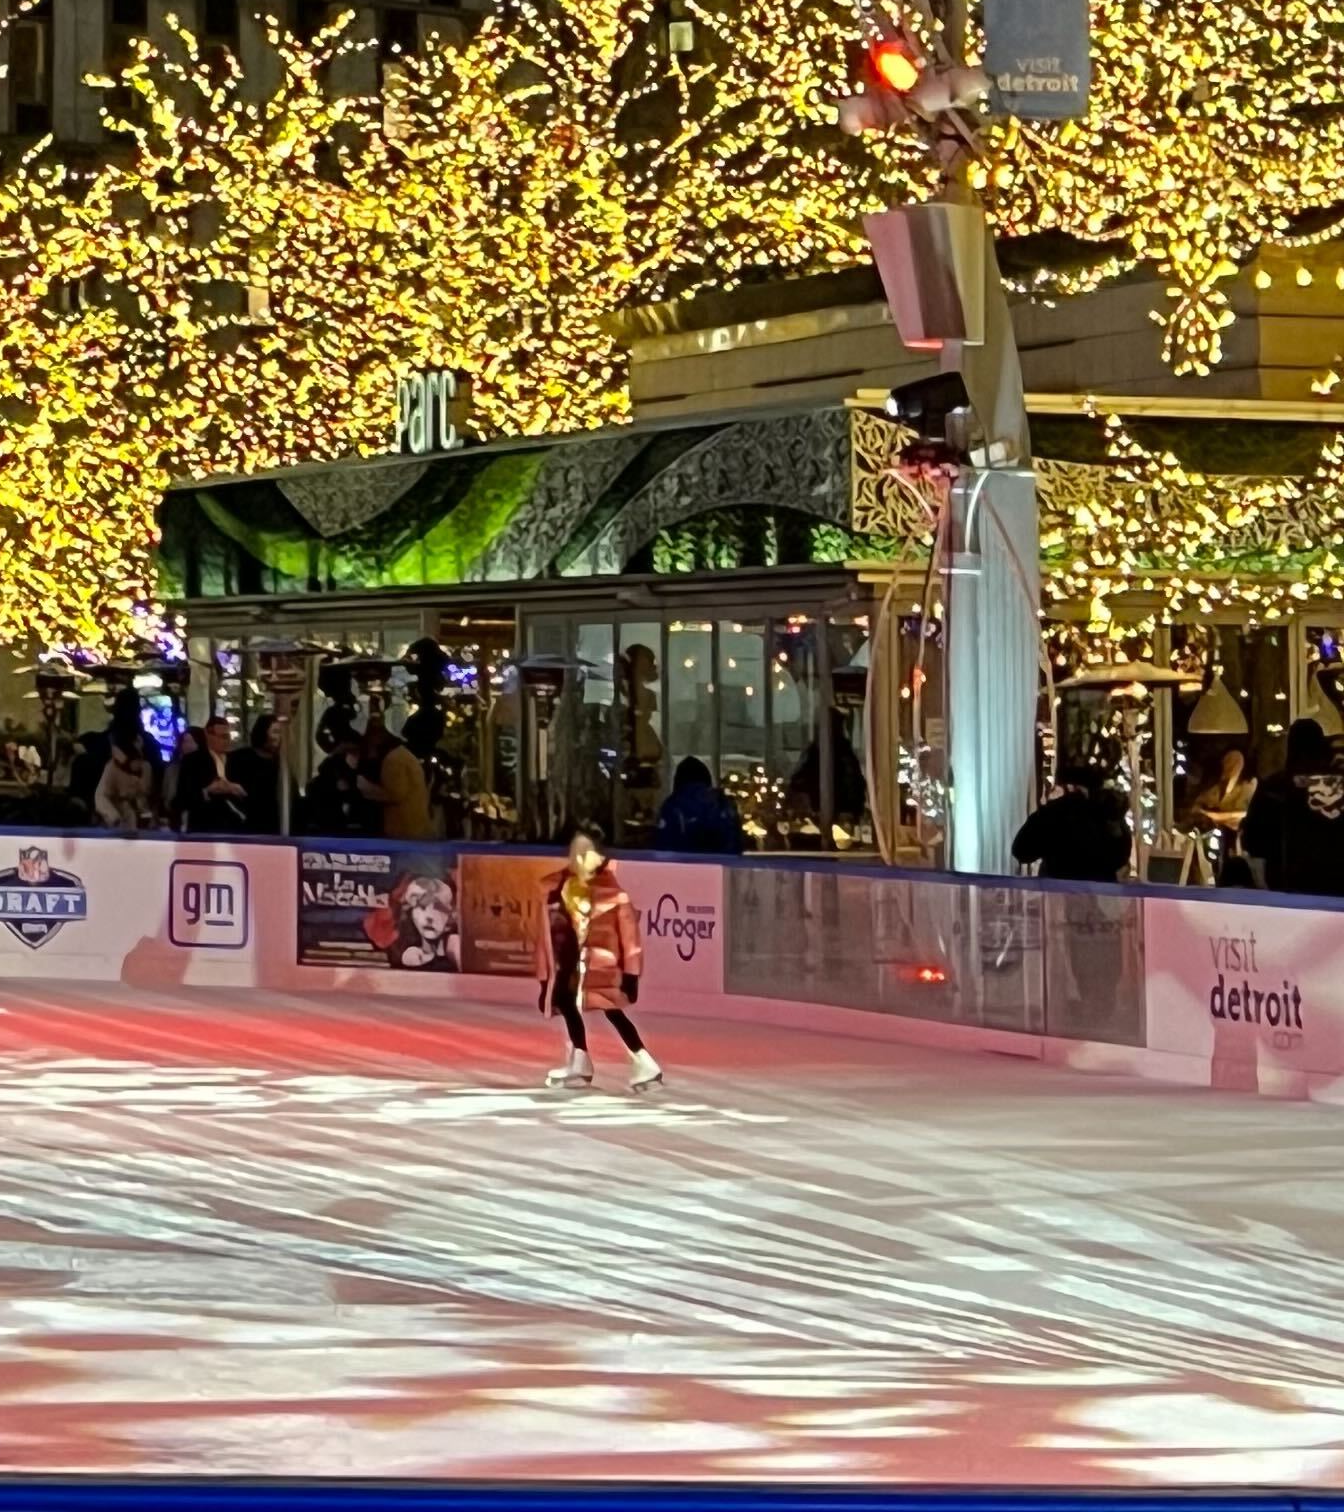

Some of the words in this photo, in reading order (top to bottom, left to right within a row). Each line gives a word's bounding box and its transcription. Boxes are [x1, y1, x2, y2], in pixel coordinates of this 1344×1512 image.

[997, 72, 1079, 93] detroit
[183, 882, 234, 925] gm
[647, 893, 716, 962] Kroger
[1209, 930, 1259, 973] visit
[1210, 973, 1304, 1031] detroit
